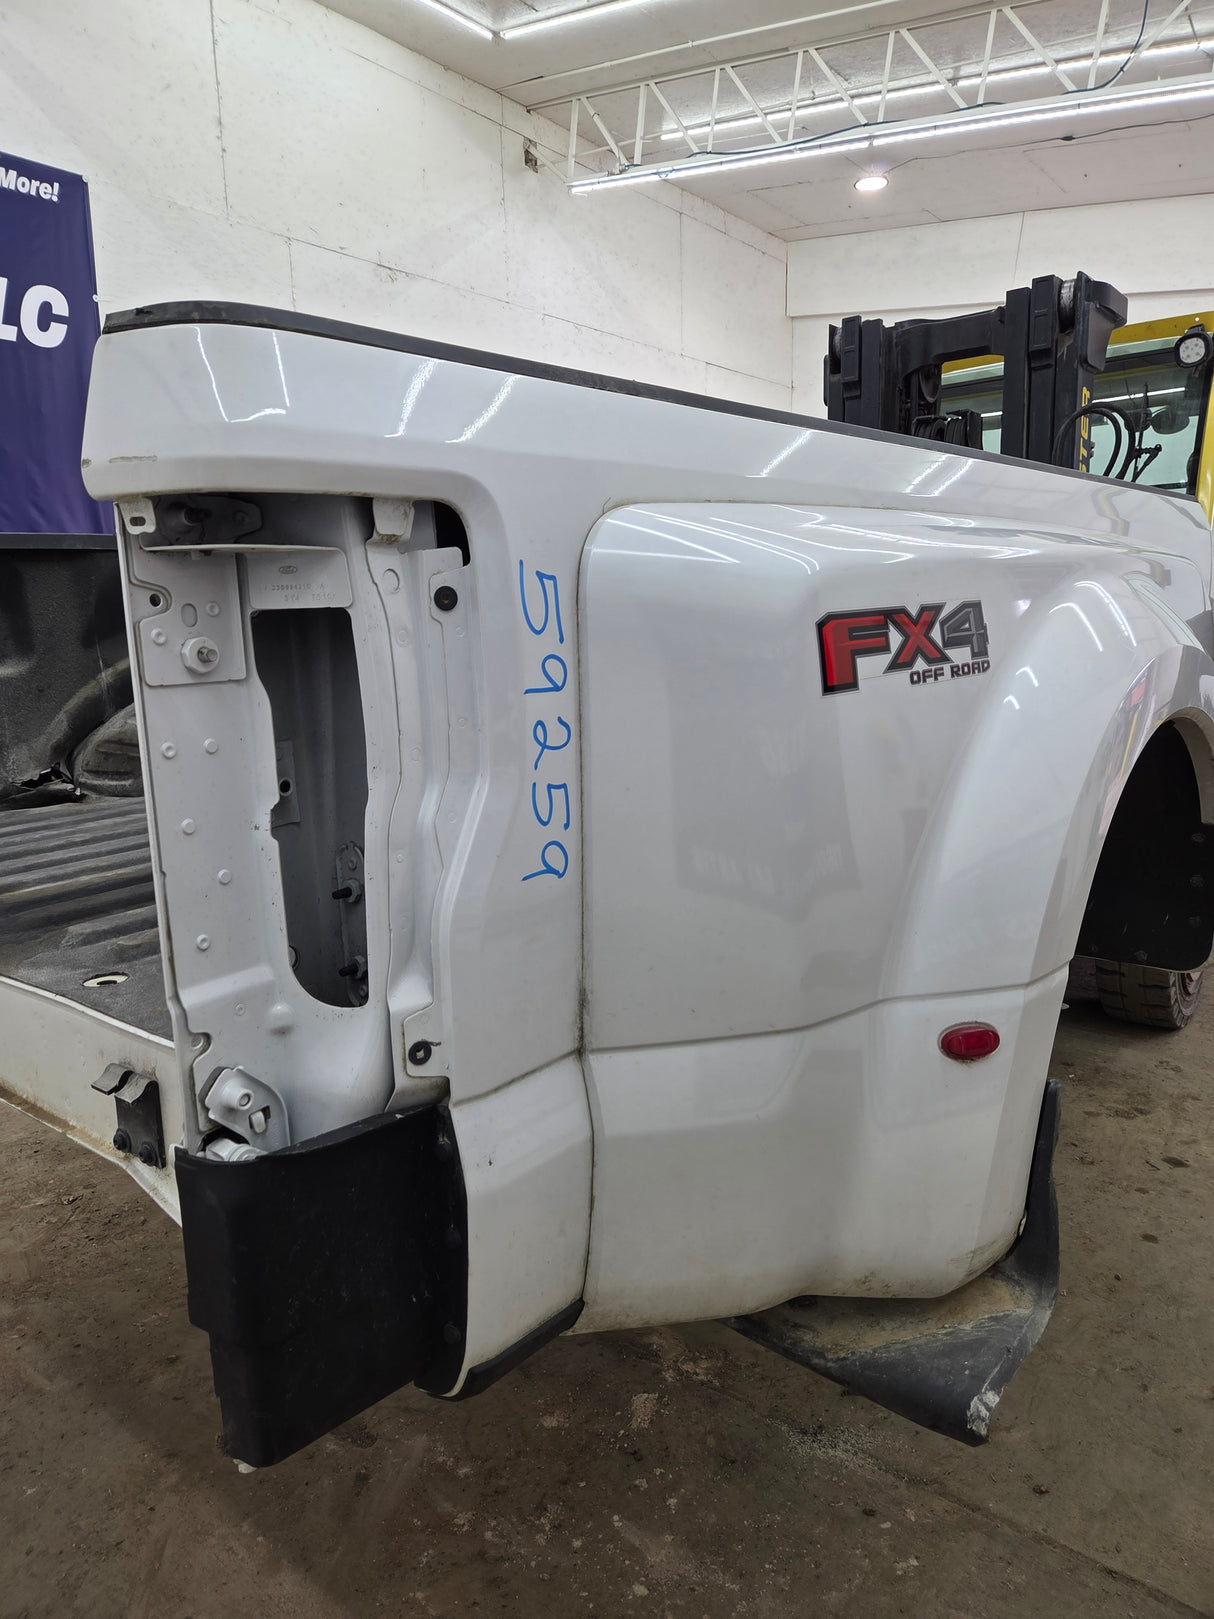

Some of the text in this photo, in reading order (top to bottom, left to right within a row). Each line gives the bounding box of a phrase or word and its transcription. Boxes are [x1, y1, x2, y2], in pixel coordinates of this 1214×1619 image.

[0, 167, 60, 202] More!
[815, 600, 990, 696] FX4
[909, 659, 991, 685] OFF ROAD
[519, 559, 572, 881] 59259
